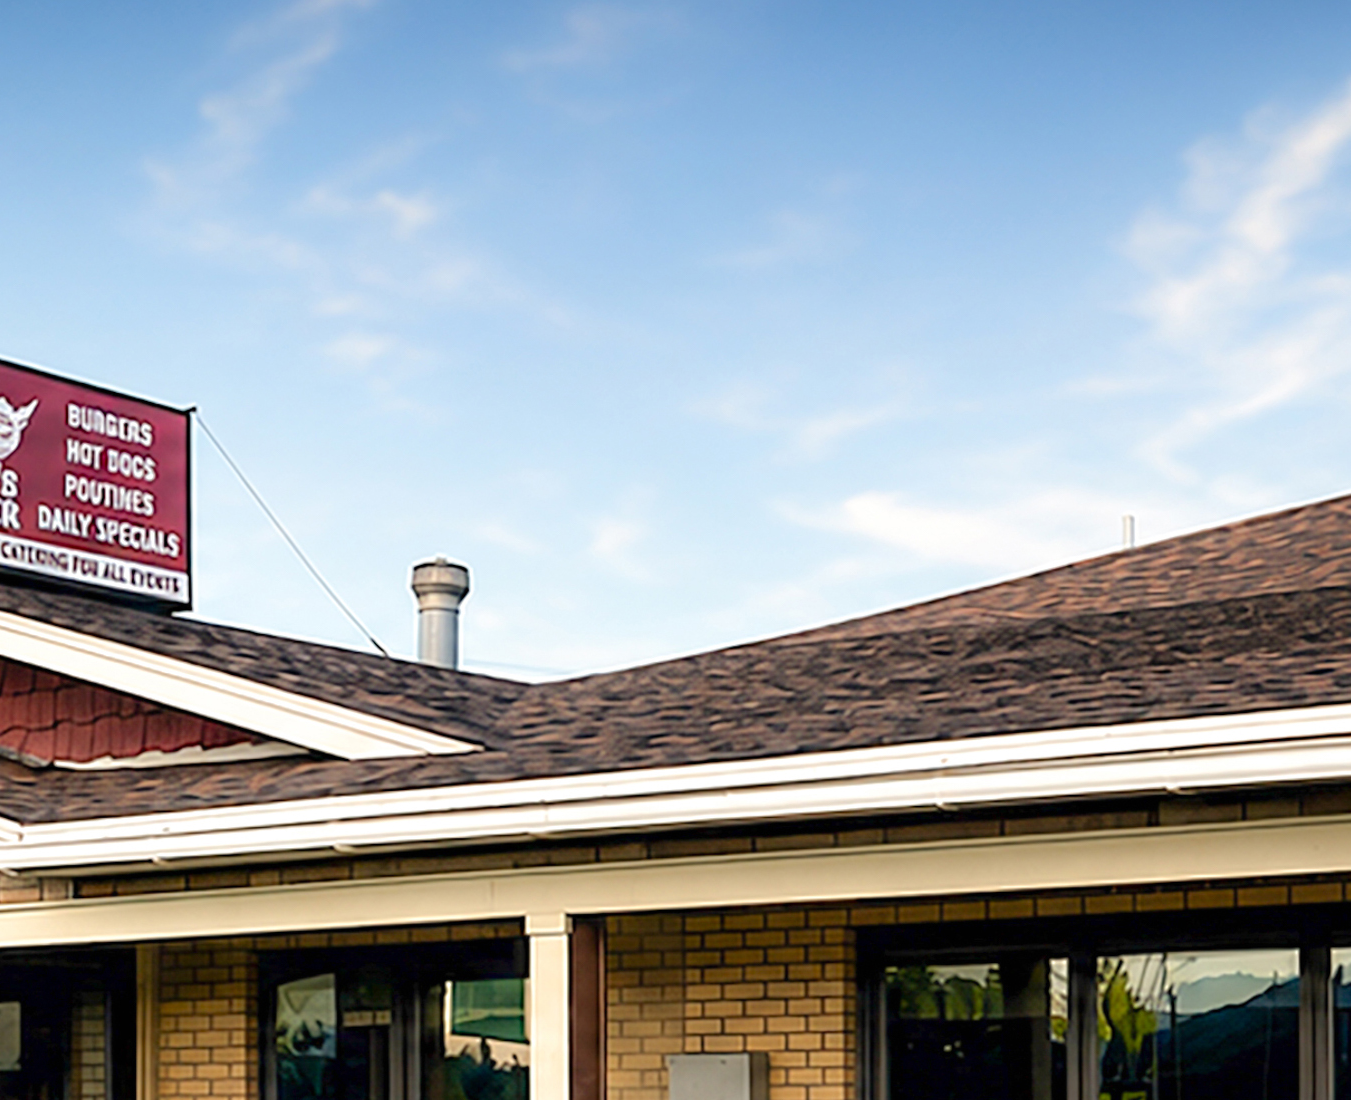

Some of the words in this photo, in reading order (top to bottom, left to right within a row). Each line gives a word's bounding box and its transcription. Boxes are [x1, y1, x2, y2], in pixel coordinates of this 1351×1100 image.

[67, 402, 153, 447] BURGERS
[66, 438, 104, 470] HOT
[107, 449, 157, 482] DOGS
[64, 473, 154, 517] POUTINES
[37, 504, 92, 538] DAILY
[95, 516, 181, 558] SPECIALS
[0, 541, 69, 572] CATERING
[72, 555, 99, 577] FOR
[102, 562, 127, 583] ALL
